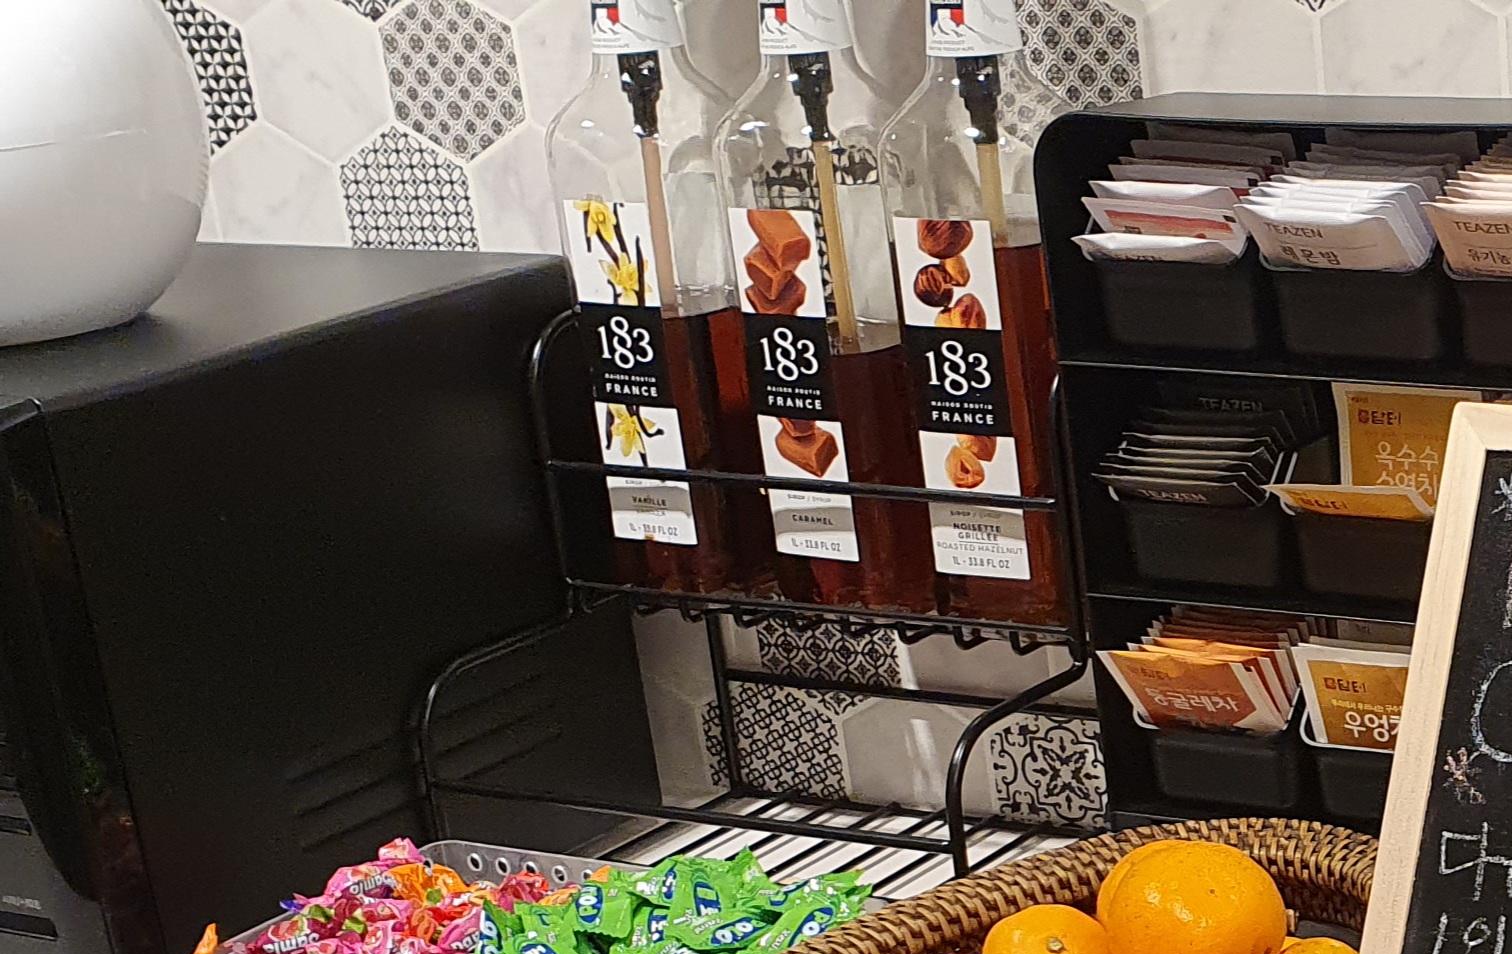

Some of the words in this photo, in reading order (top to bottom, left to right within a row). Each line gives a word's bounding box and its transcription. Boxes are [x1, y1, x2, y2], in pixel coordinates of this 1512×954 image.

[1264, 220, 1323, 239] TEAZEN
[606, 383, 659, 398] FRANCE
[767, 395, 823, 411] FRANCE
[931, 410, 995, 425] FRANCE
[1375, 440, 1439, 472] 옥수수
[792, 513, 834, 526] CARAMEL
[952, 522, 1002, 534] NOISETTE
[936, 541, 977, 553] ROASTED
[977, 543, 1024, 556] HAZELNUT
[1145, 686, 1239, 714] 둥글레차
